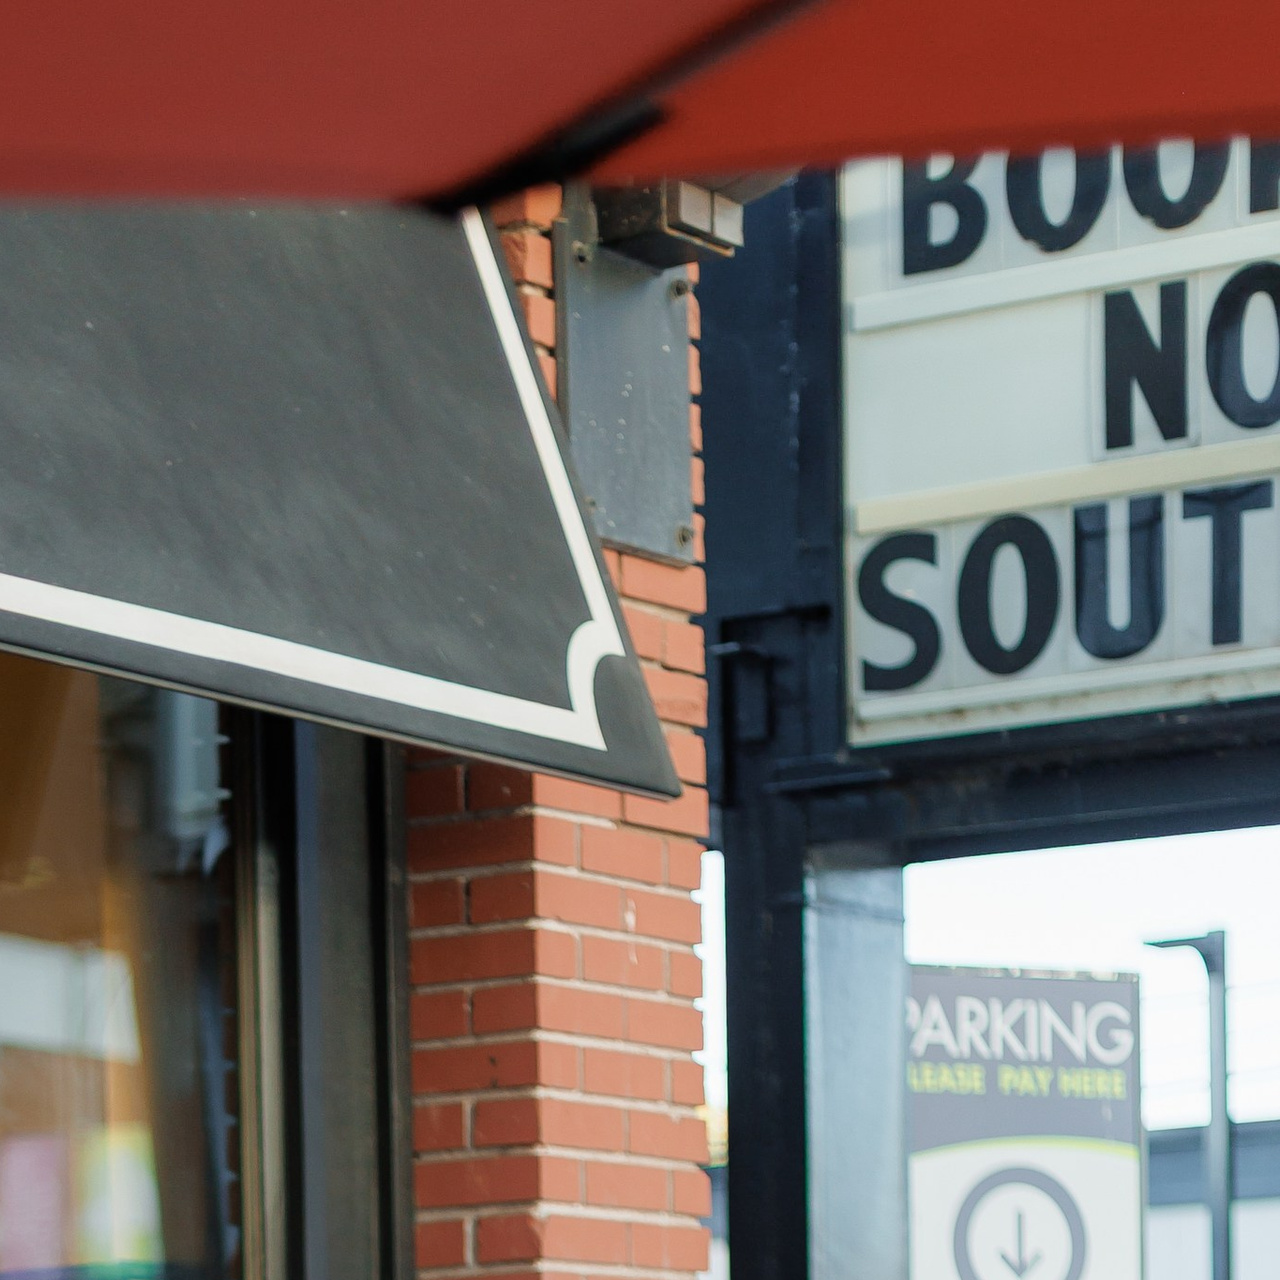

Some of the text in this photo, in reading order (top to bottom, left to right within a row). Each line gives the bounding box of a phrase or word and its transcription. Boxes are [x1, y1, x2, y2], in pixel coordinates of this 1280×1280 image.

[857, 480, 1273, 694] SOUT
[998, 1063, 1053, 1098] PAY
[1057, 1067, 1126, 1100] HERE
